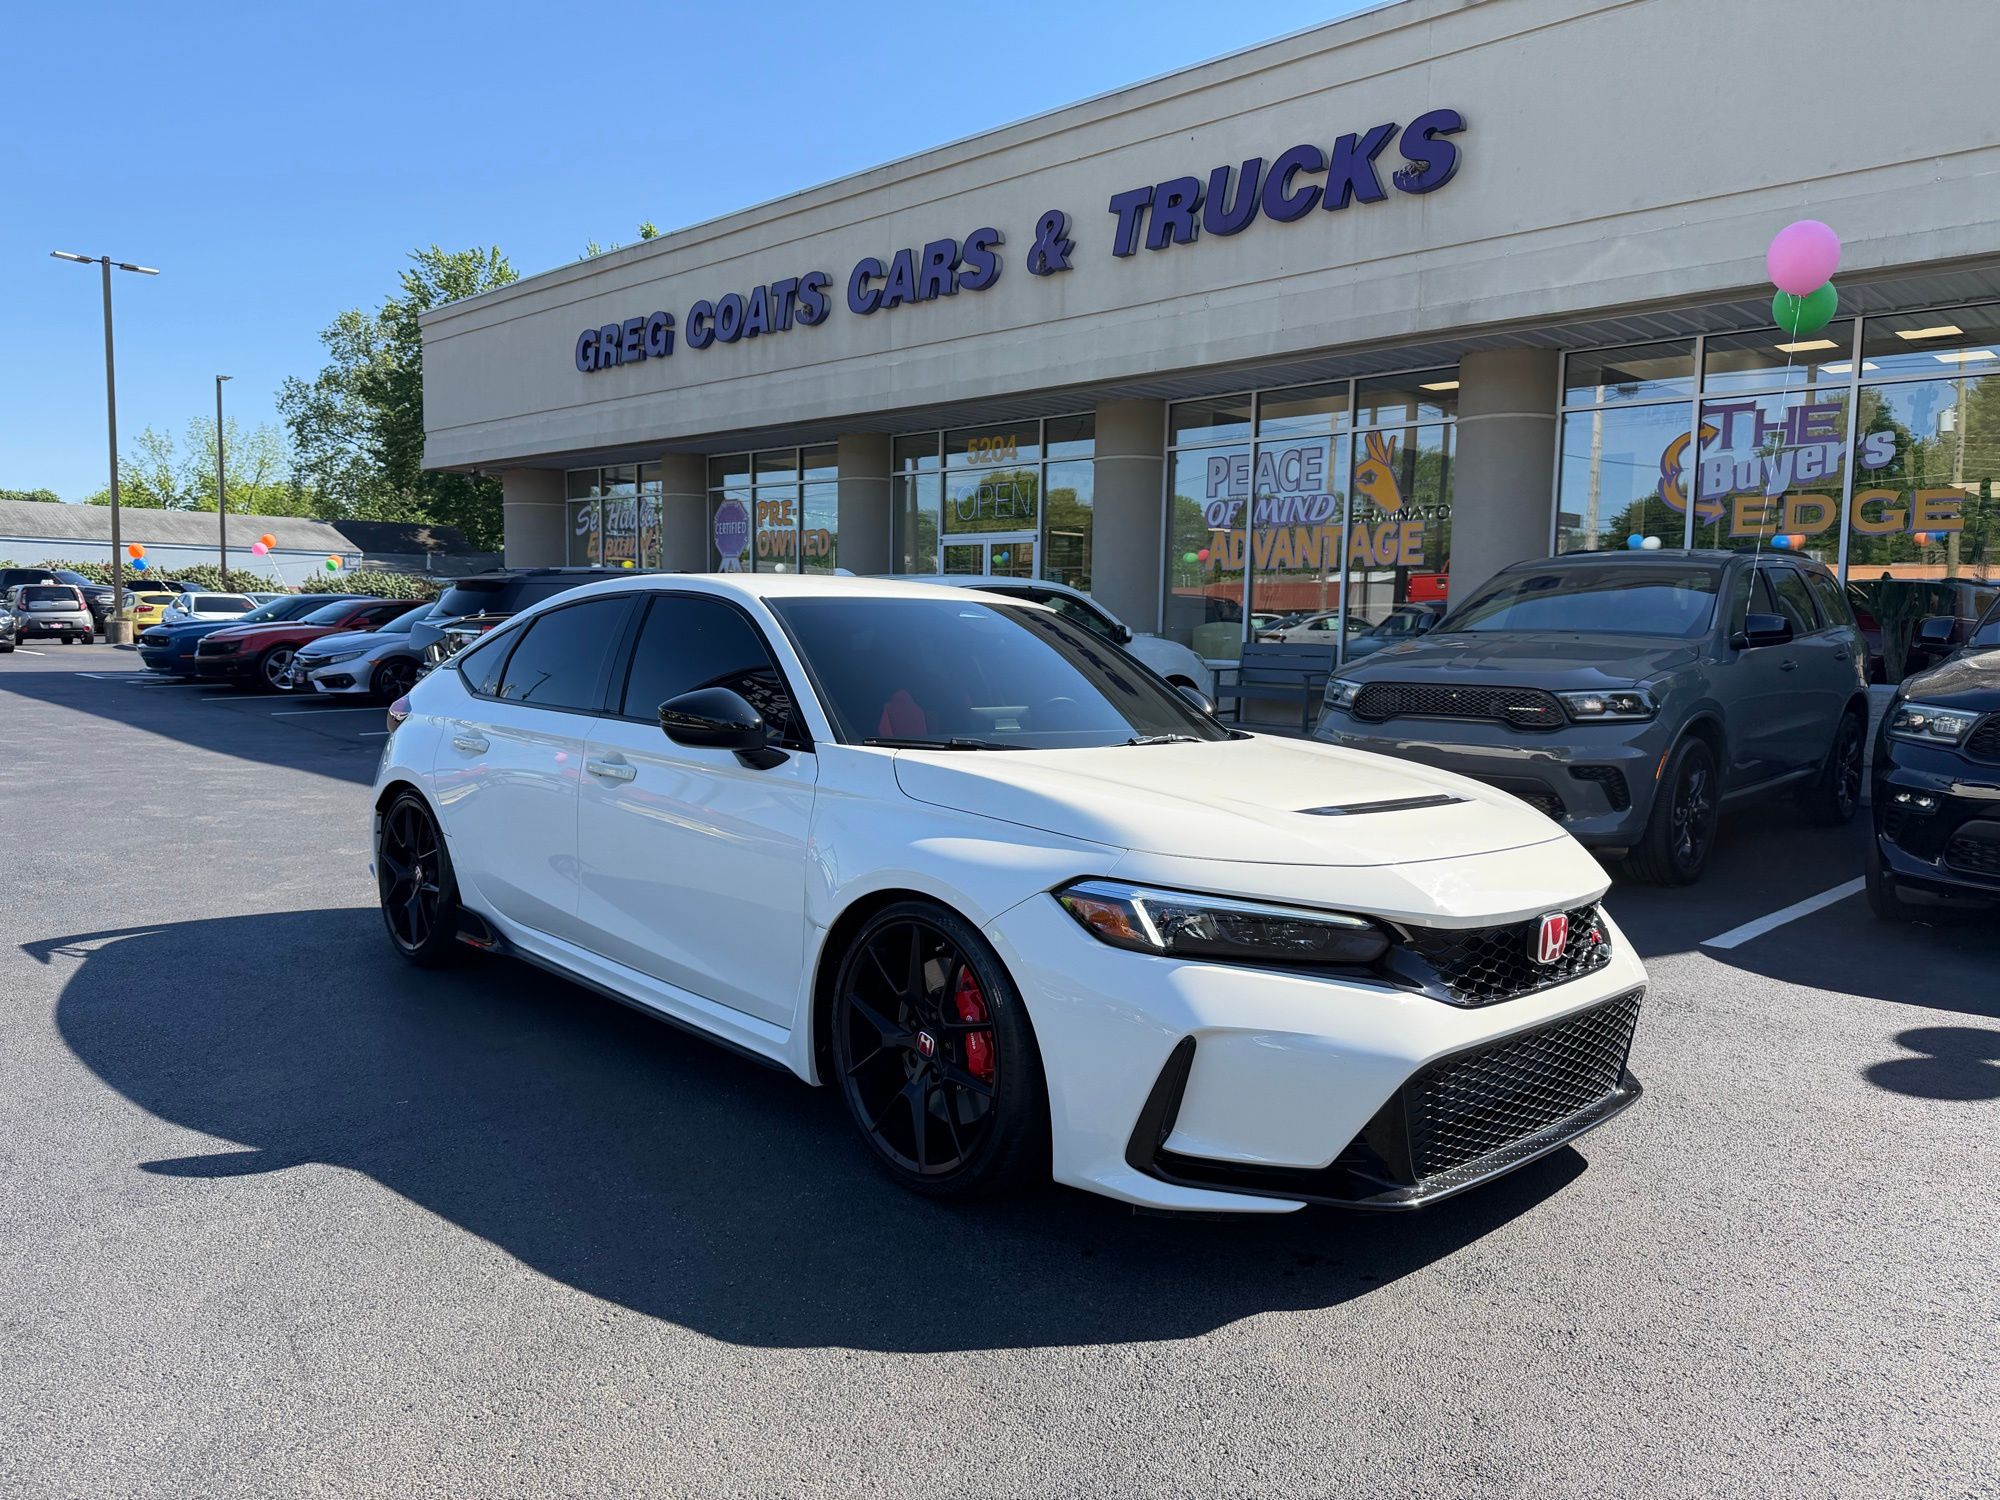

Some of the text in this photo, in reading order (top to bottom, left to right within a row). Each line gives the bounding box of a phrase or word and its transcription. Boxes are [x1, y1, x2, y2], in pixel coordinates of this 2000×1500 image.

[575, 108, 1466, 372] GREG COATS CARS & TRUCKS
[1701, 400, 1843, 450] THE
[966, 434, 1018, 465] 5204
[1700, 429, 1897, 500] Buyer's
[1206, 447, 1322, 498] PEACE
[575, 497, 659, 536] Se Habla
[757, 499, 798, 527] PRE-
[957, 479, 1031, 521] OPEN
[1206, 494, 1336, 529] OF MIND
[1729, 487, 1966, 536] EDGE
[715, 521, 747, 535] CERTIFIED
[757, 528, 830, 558] OWNED
[1204, 521, 1425, 570] ADVANTAGE
